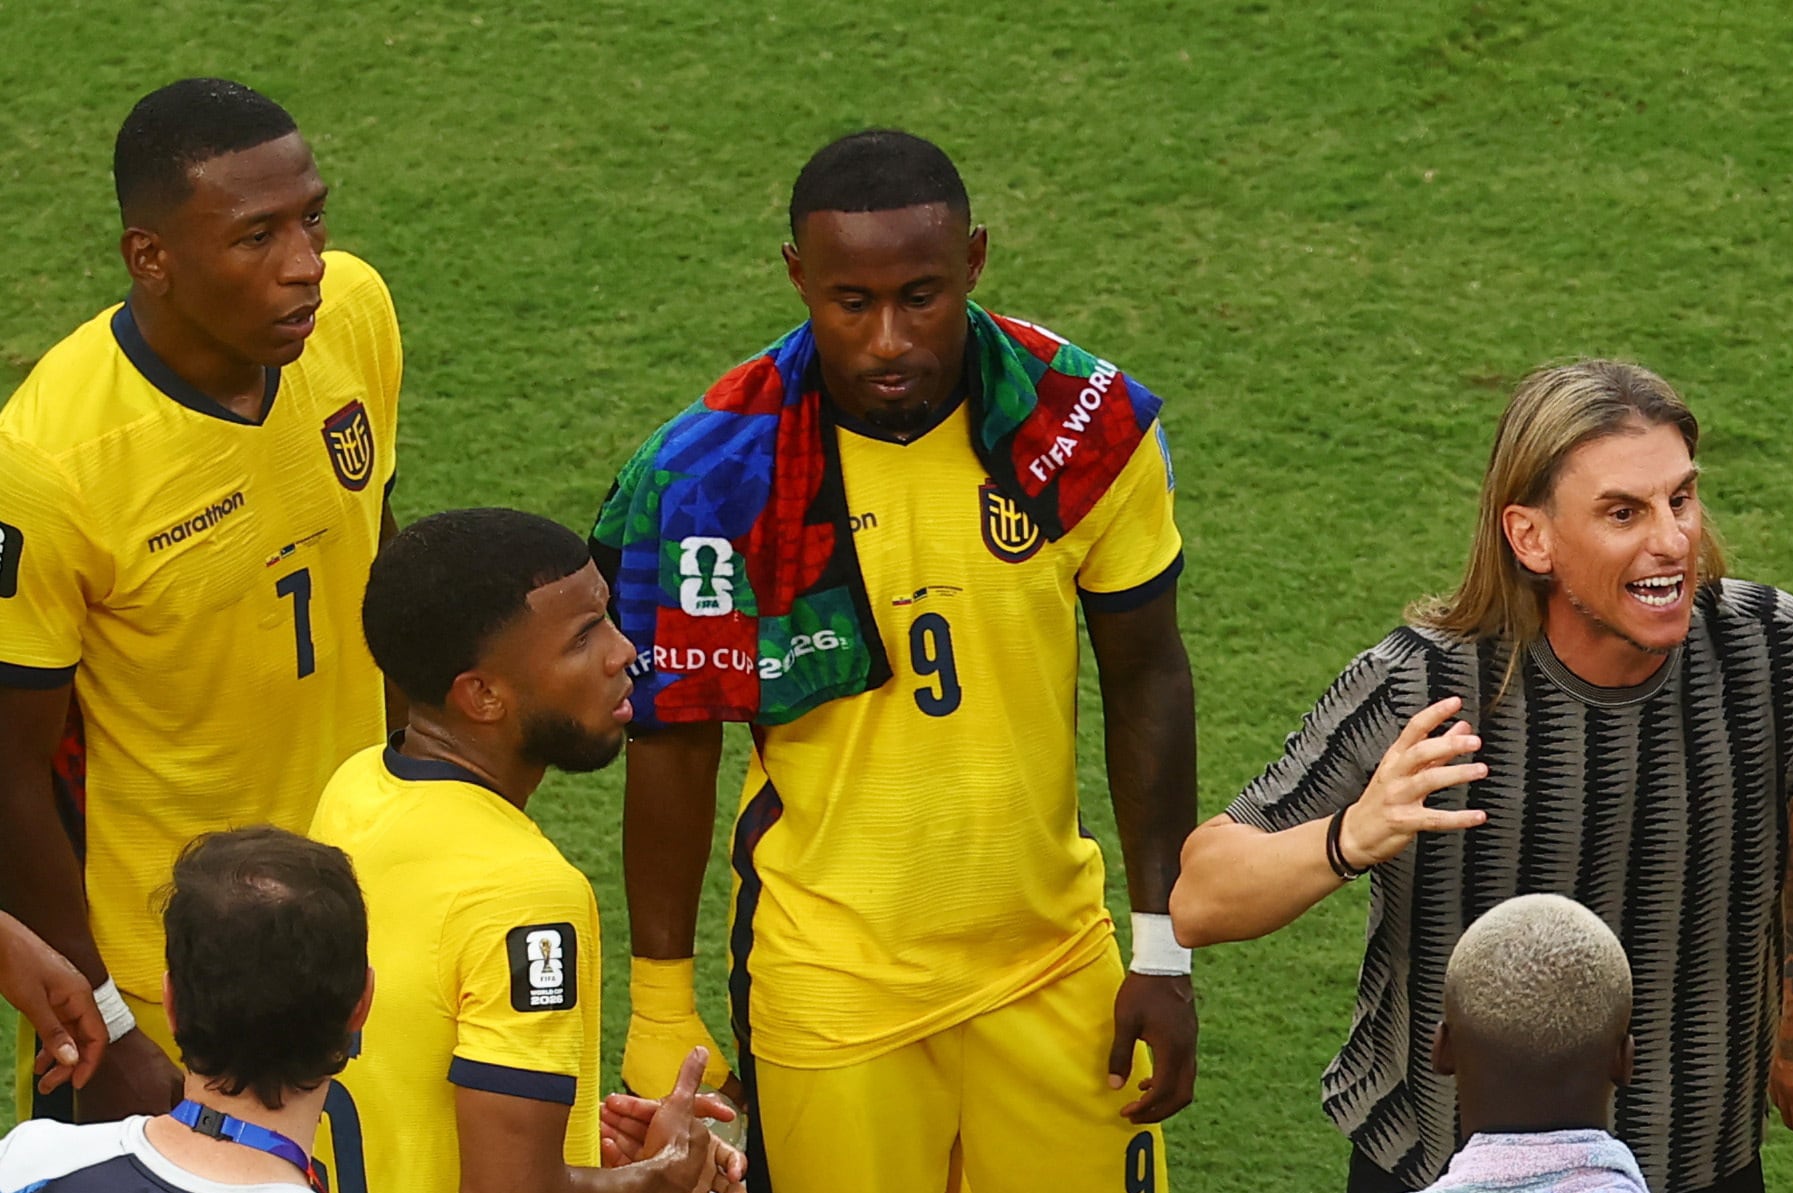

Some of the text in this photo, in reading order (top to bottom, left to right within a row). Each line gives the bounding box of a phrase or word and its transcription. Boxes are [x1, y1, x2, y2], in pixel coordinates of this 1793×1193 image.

[1029, 436, 1078, 482] FIFA
[148, 491, 245, 553] marathon
[653, 645, 706, 671] RLD
[713, 648, 755, 675] CUP
[908, 612, 962, 718] 9
[530, 995, 564, 1006] 2026
